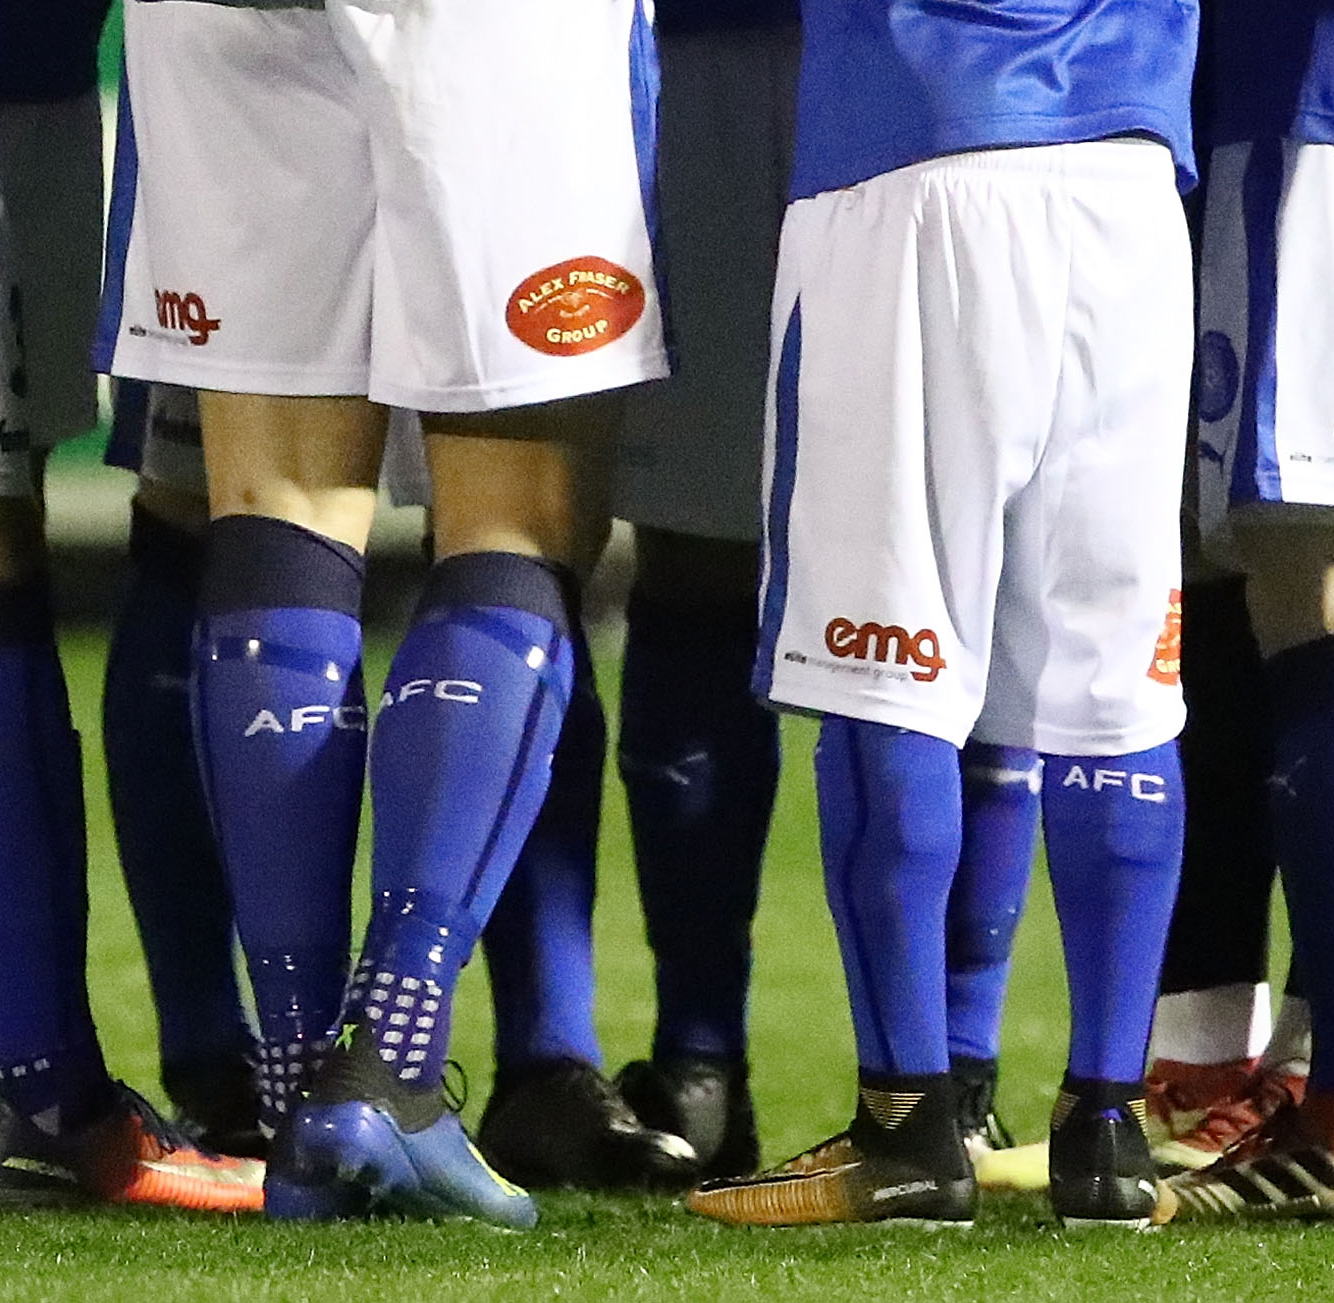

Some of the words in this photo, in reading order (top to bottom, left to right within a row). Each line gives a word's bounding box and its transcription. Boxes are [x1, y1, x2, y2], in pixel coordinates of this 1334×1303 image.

[518, 277, 565, 314] ALEX
[568, 270, 631, 295] FRASER
[546, 319, 609, 344] GROUP
[824, 617, 948, 683] emg
[379, 679, 483, 710] AFC
[244, 704, 366, 738] AFC
[1063, 764, 1166, 803] AFC
